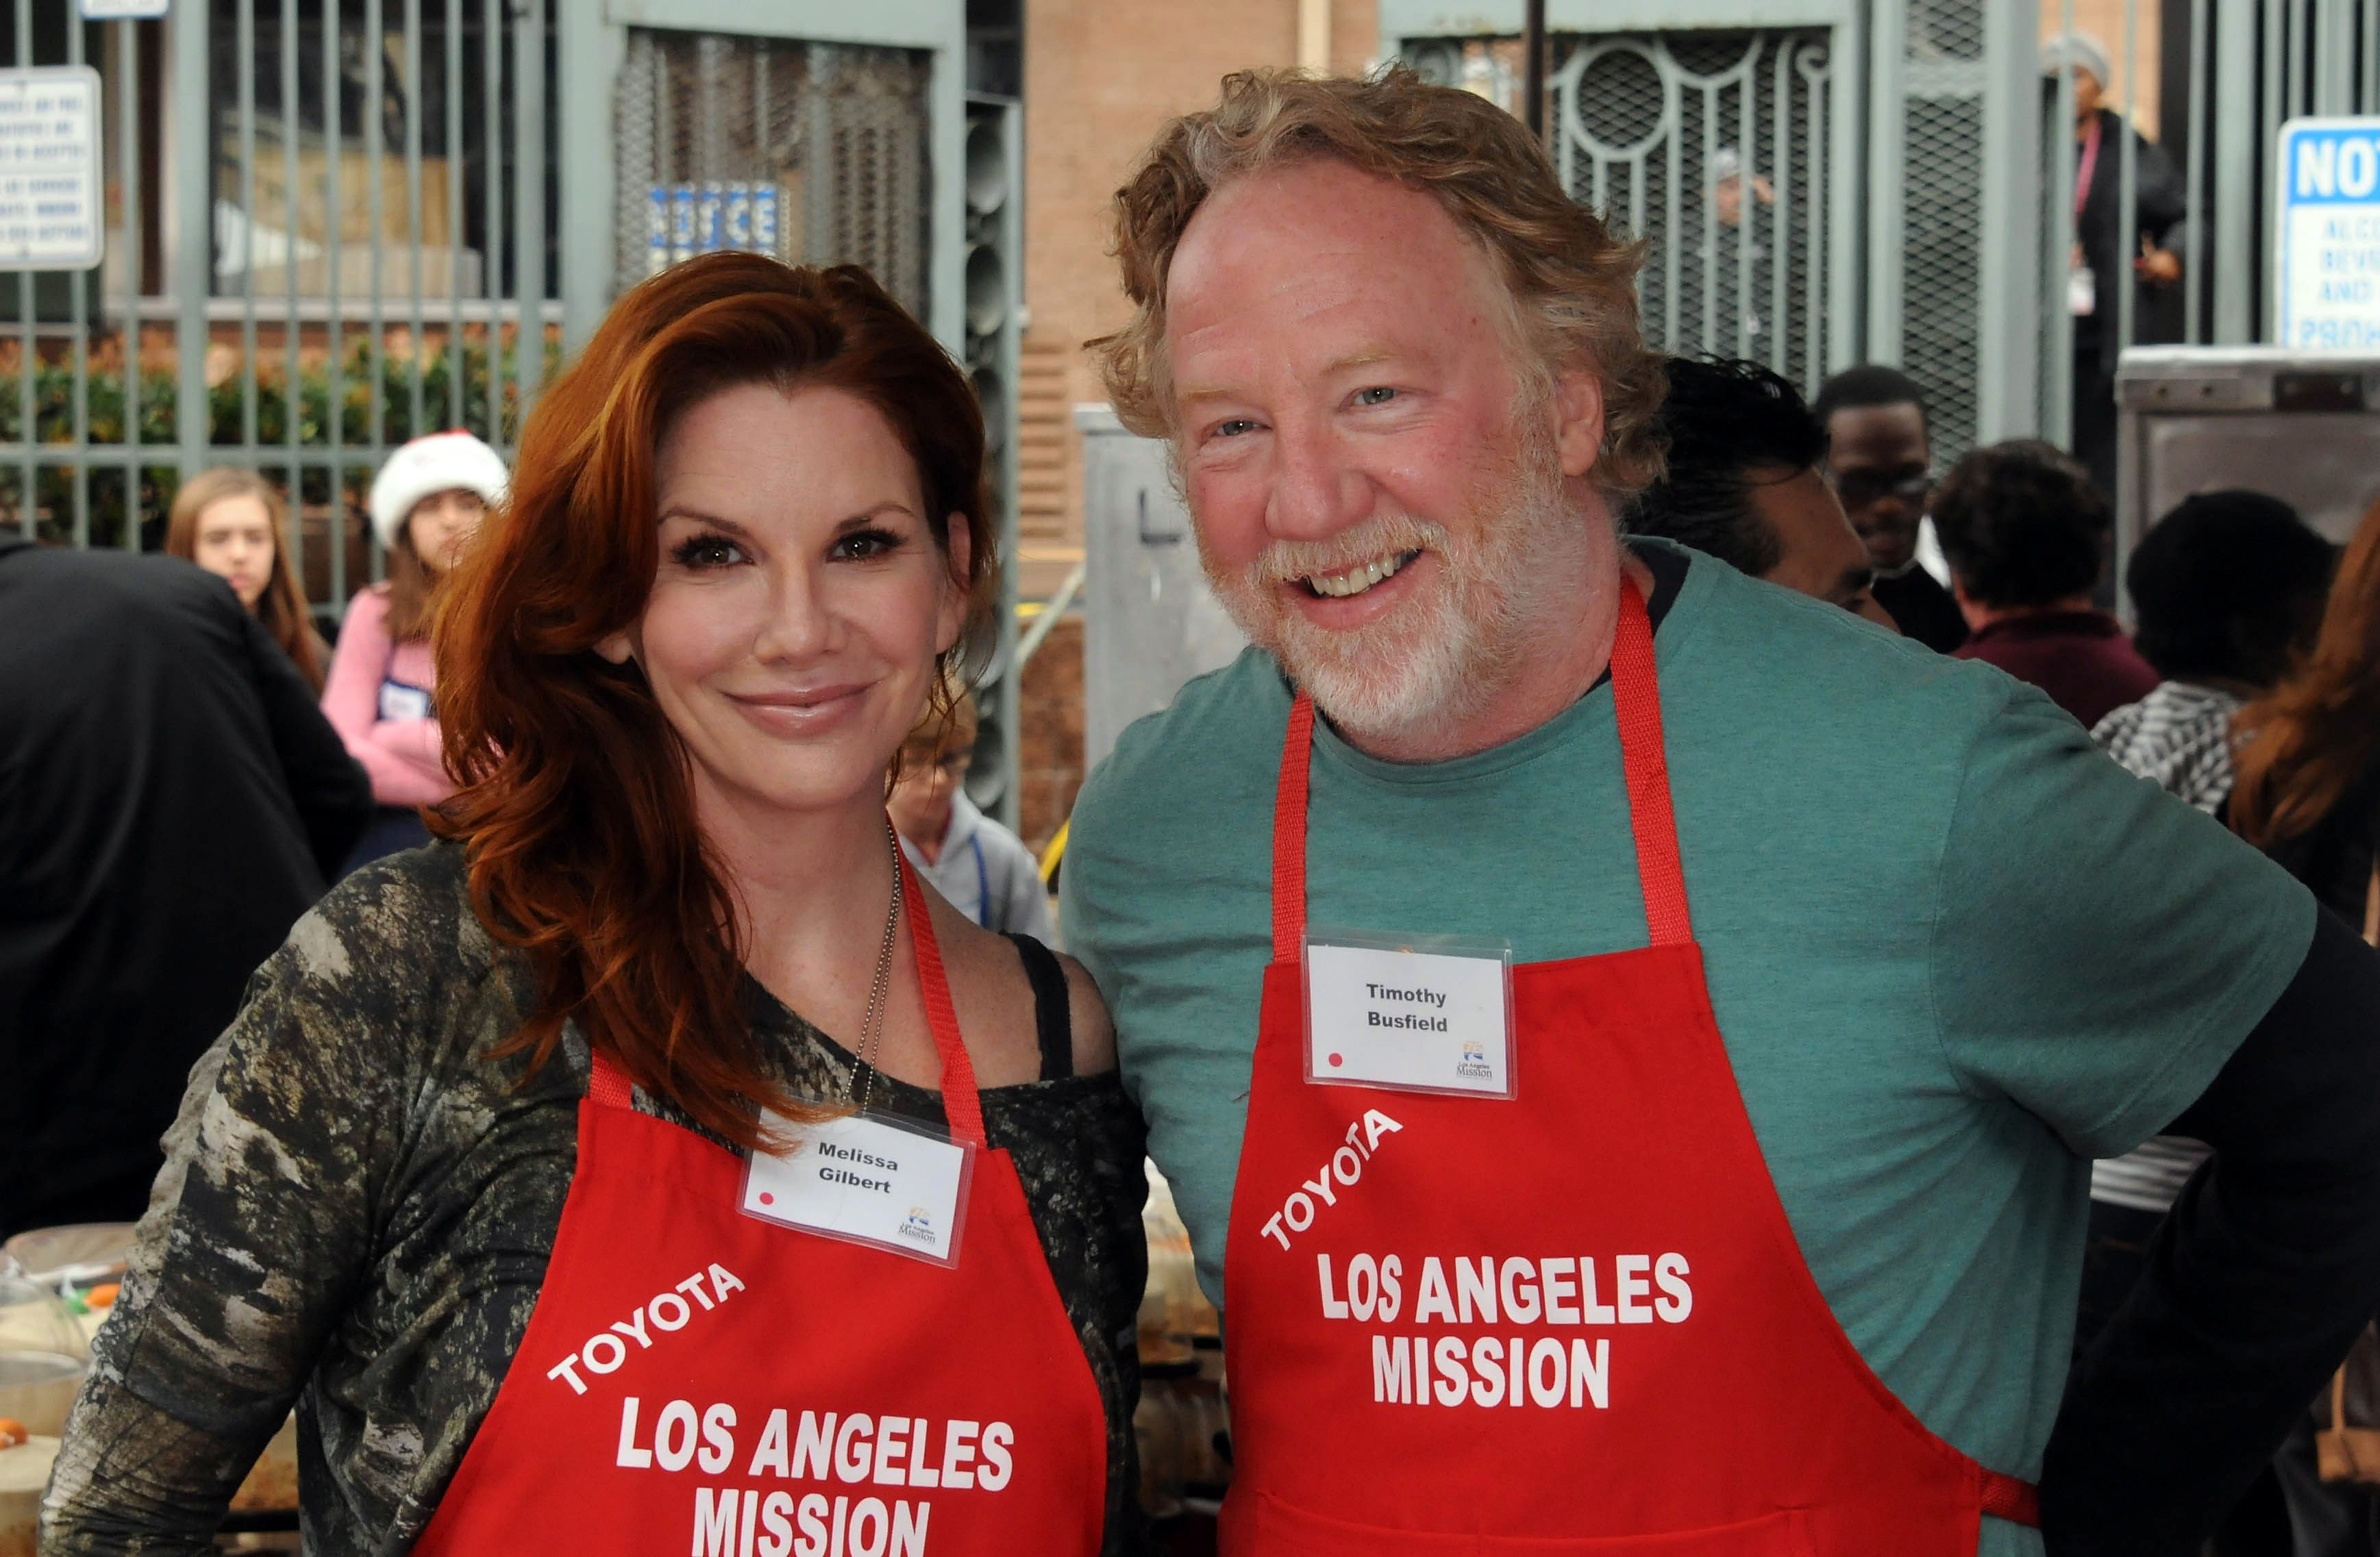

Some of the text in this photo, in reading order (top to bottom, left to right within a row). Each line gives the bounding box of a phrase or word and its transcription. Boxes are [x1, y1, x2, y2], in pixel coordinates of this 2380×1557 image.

[2296, 138, 2380, 197] NO
[2320, 280, 2370, 301] AND
[1366, 984, 1446, 1008] Timothy
[1367, 1011, 1448, 1032] Busfield
[1456, 1066, 1492, 1078] Mission
[818, 1142, 898, 1171] Melissa
[819, 1167, 891, 1194] Gilbert
[1261, 1108, 1404, 1251] TOYOTA
[898, 1225, 936, 1244] Mission
[1317, 1252, 1693, 1324] LOS ANGELES
[547, 1263, 745, 1395] TOYOTA
[1372, 1335, 1609, 1409] MISSION
[616, 1397, 1015, 1491] LOS ANGELES
[691, 1487, 930, 1557] MISSION
